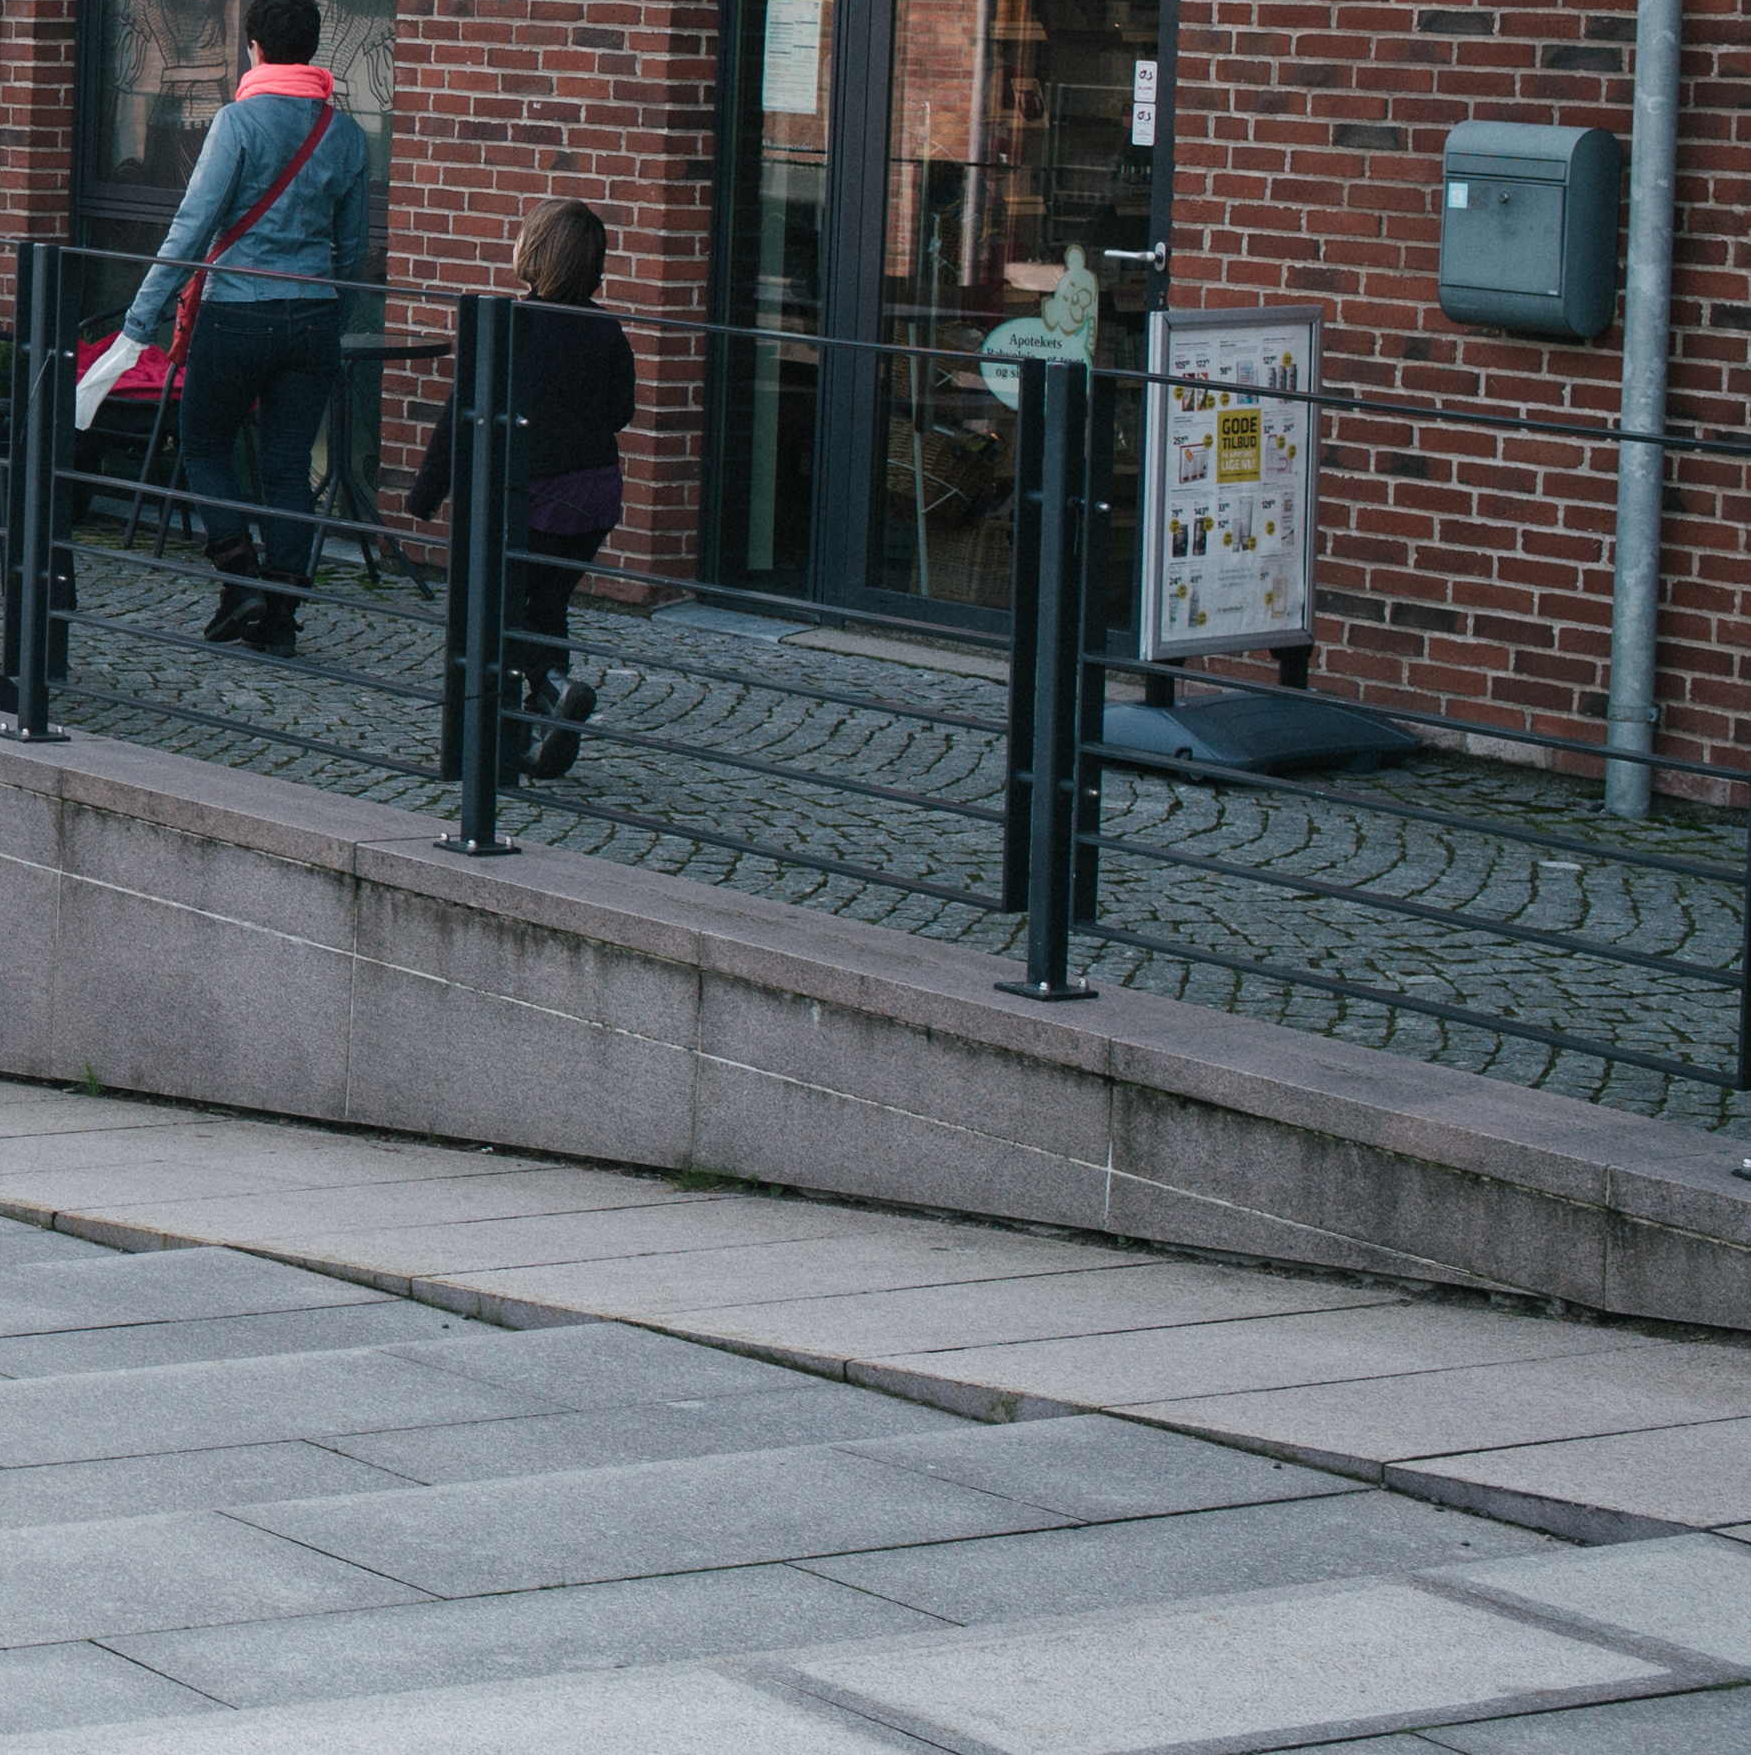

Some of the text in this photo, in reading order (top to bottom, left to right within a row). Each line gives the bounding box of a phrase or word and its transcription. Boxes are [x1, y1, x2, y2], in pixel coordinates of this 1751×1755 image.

[1009, 334, 1062, 349] Apotekets
[995, 368, 1007, 380] og
[1222, 417, 1257, 435] GODE
[1222, 435, 1257, 449] TILBUD
[1221, 458, 1240, 471] LIGE
